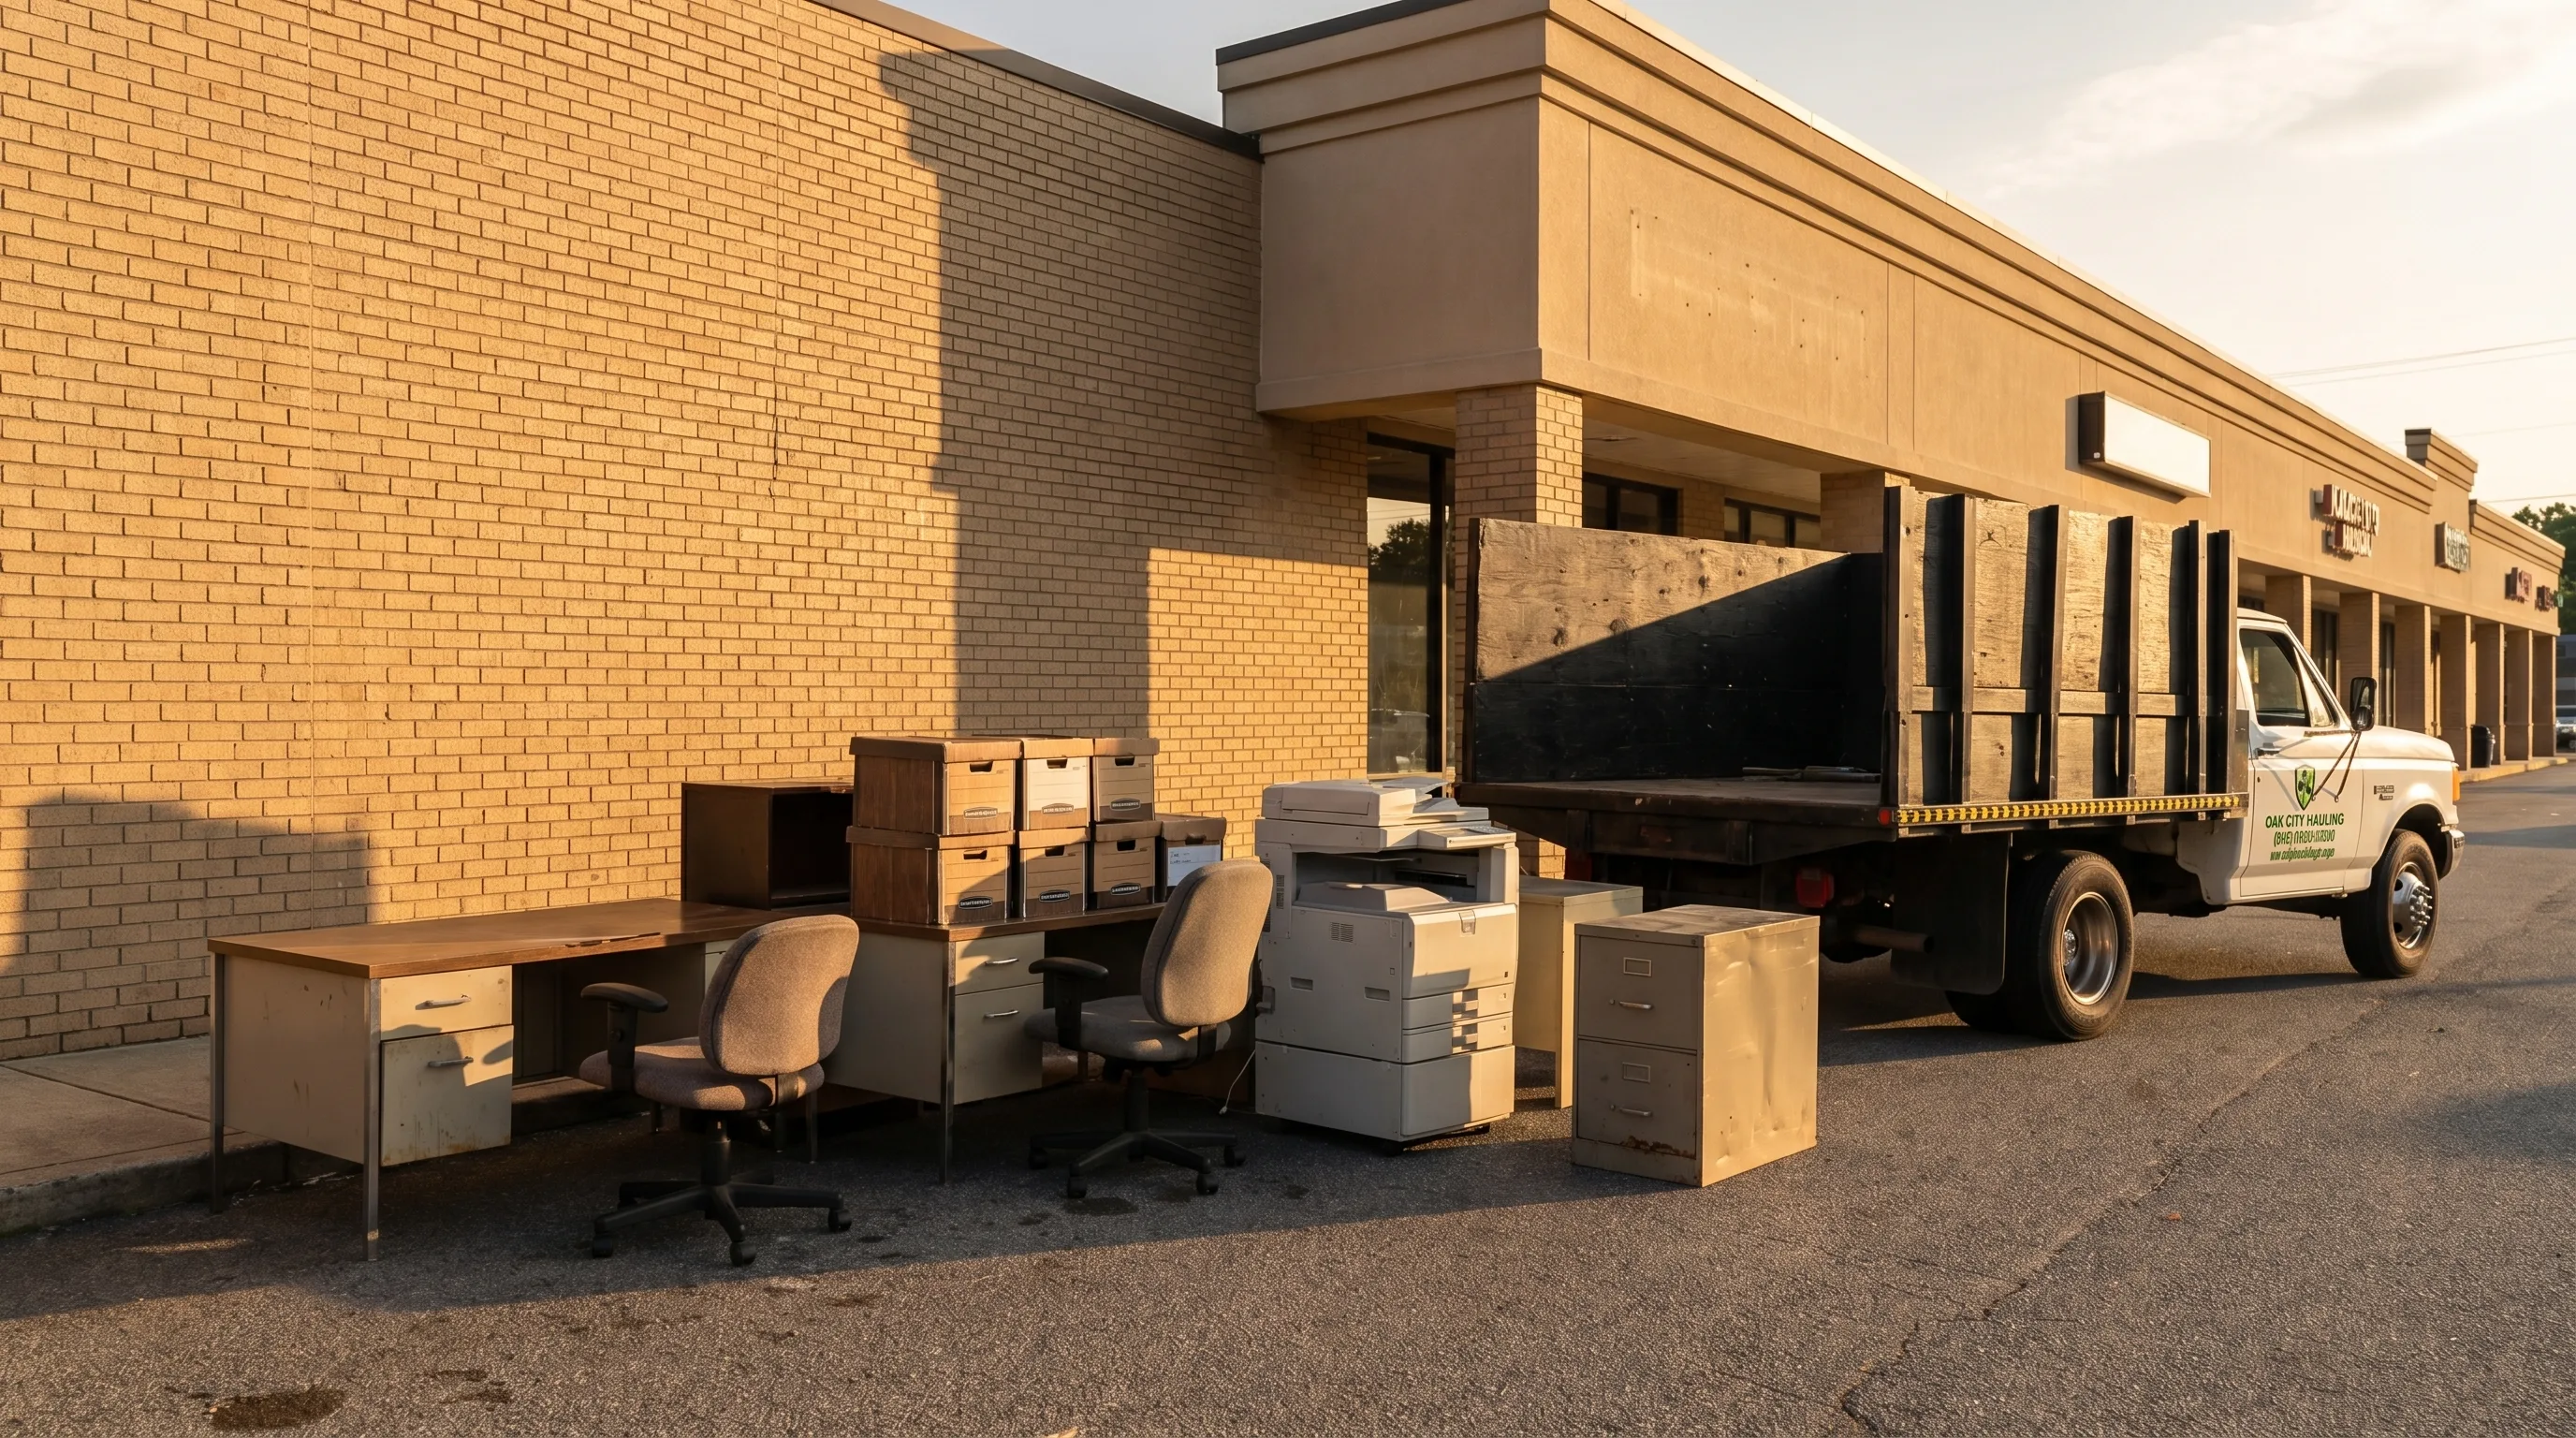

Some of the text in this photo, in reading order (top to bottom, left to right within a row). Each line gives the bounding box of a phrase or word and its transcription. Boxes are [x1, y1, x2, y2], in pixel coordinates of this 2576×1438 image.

[2265, 813, 2344, 829] OAK CITY HAULING
